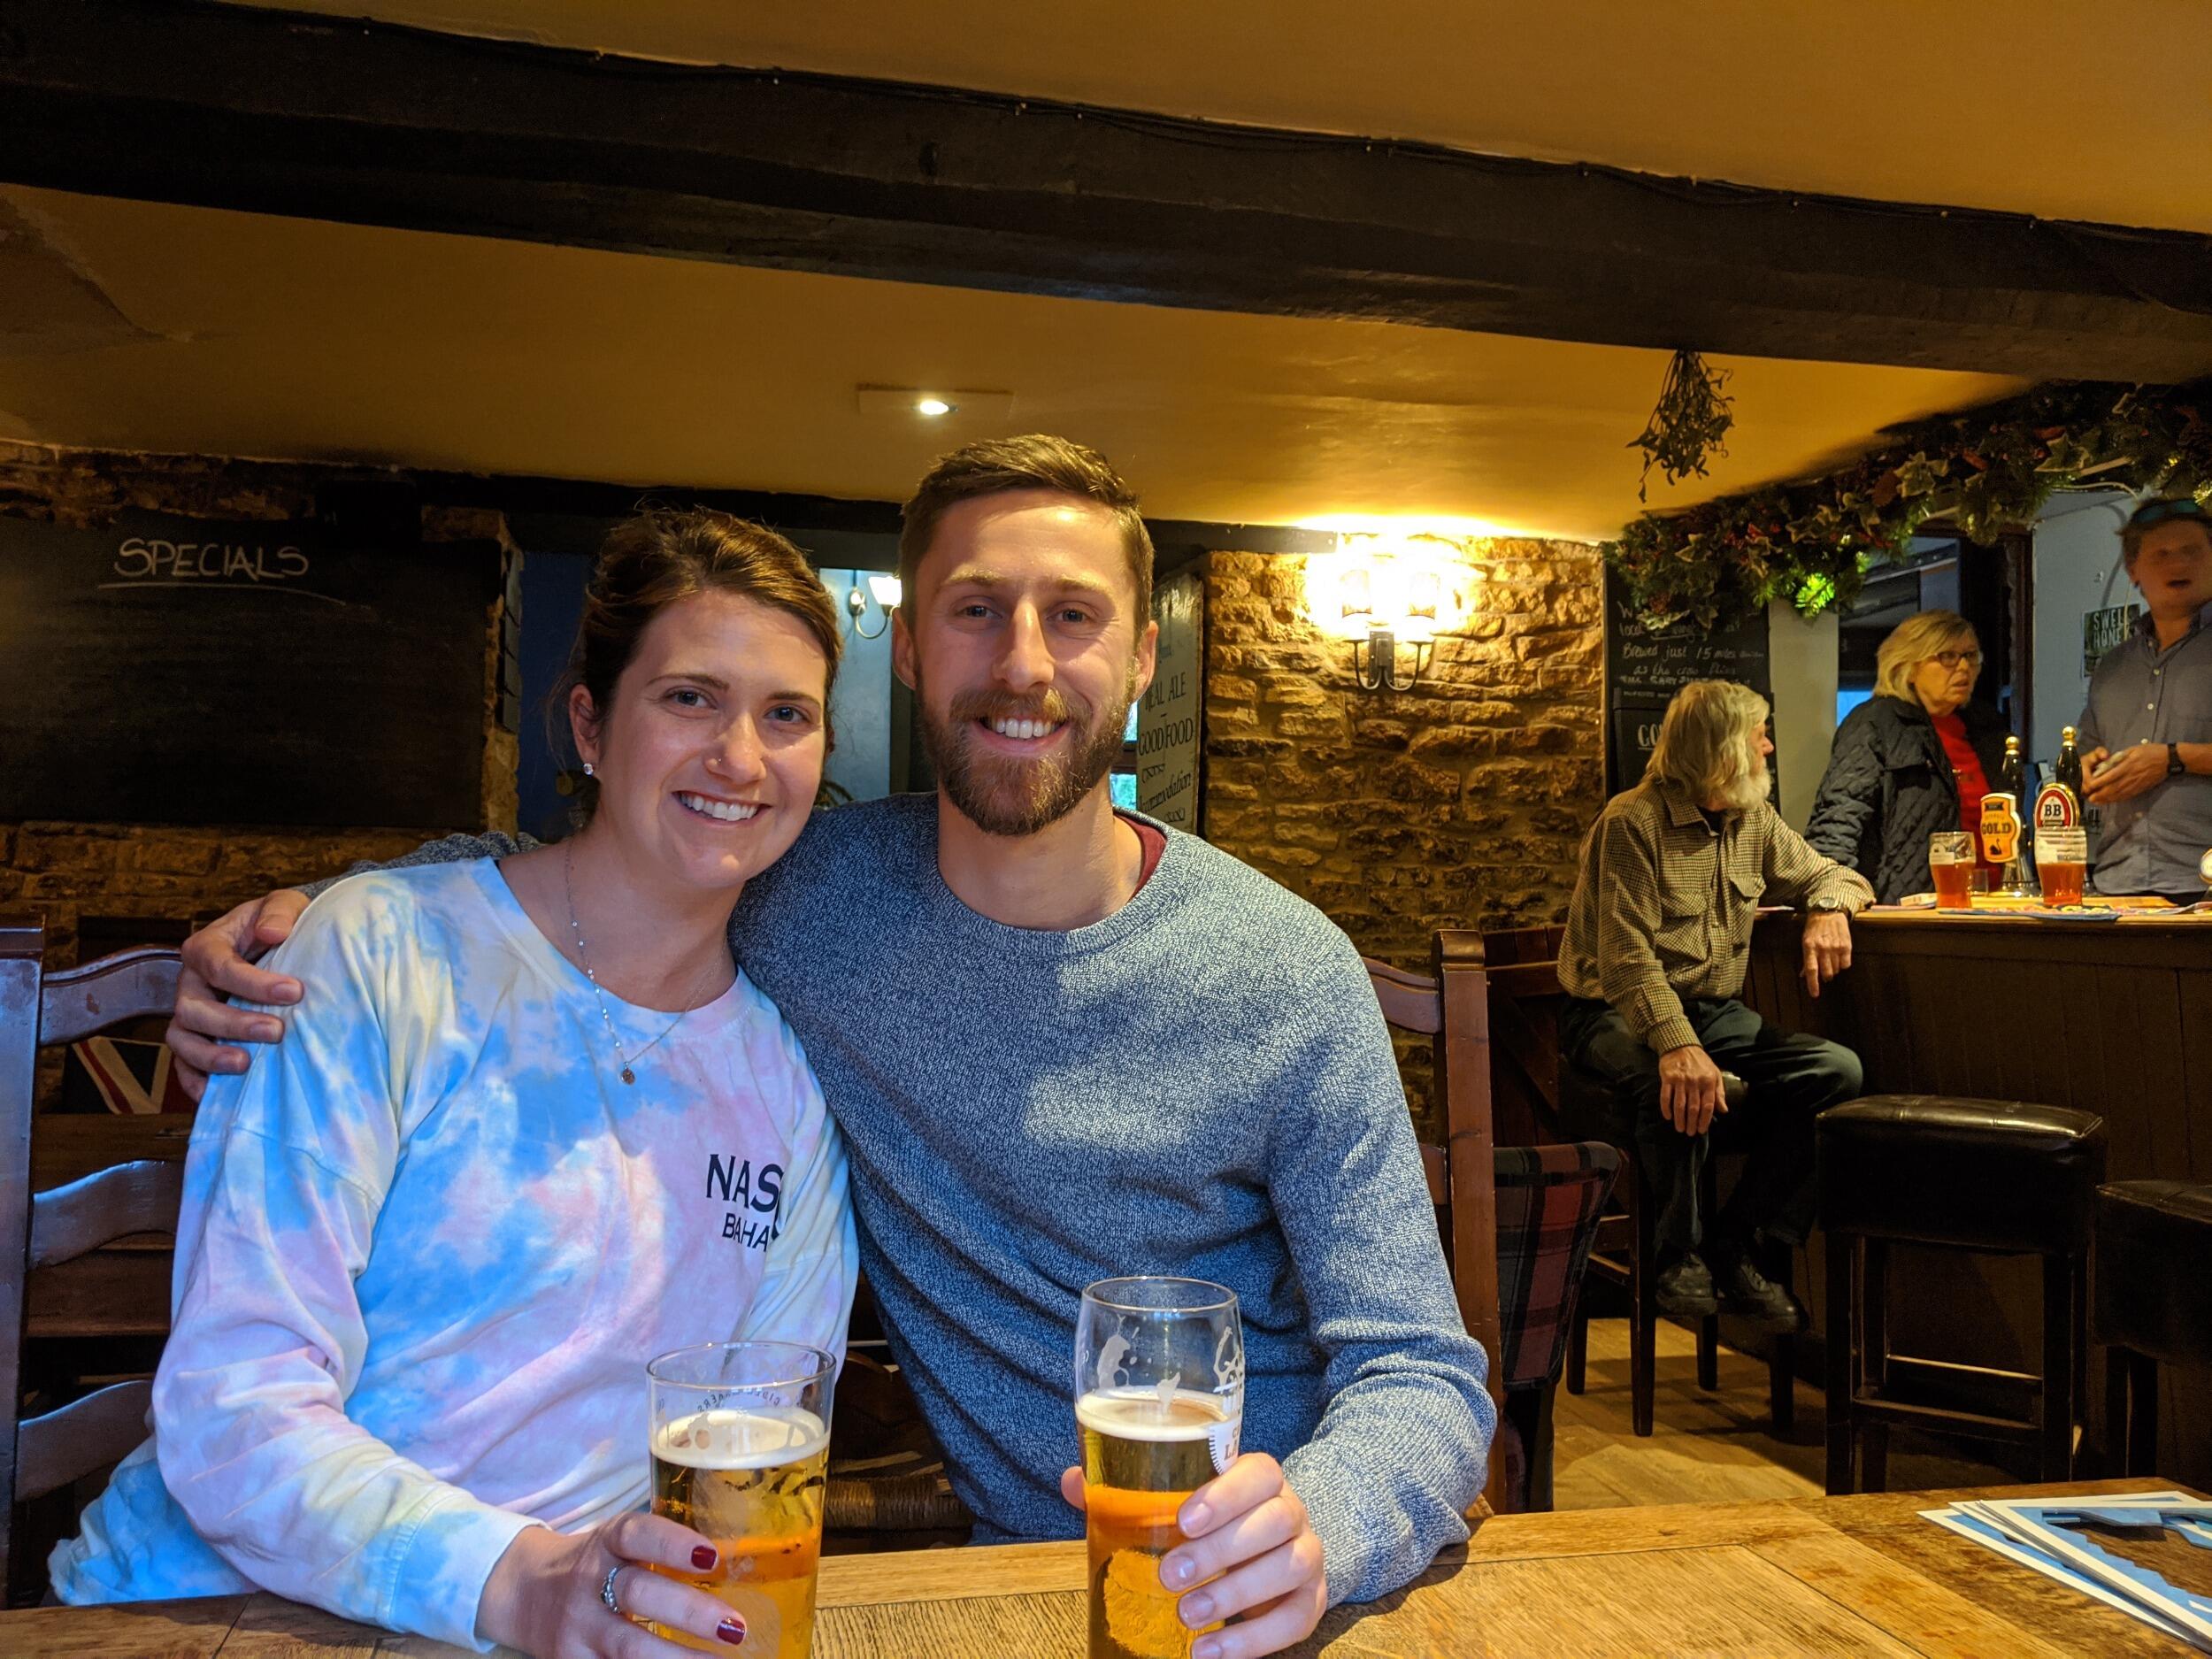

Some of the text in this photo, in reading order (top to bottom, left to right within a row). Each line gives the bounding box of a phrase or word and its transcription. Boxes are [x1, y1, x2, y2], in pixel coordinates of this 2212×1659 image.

[113, 535, 310, 581] SPECIALS
[1663, 645, 1687, 662] just
[1696, 647, 1713, 660] 15
[1653, 662, 1671, 675] the
[1169, 672, 1187, 702] ALE
[1139, 718, 1194, 756] GOOD FOOD
[2044, 804, 2062, 817] BB
[1981, 822, 2012, 835] GOLD
[706, 1154, 784, 1215] NAS
